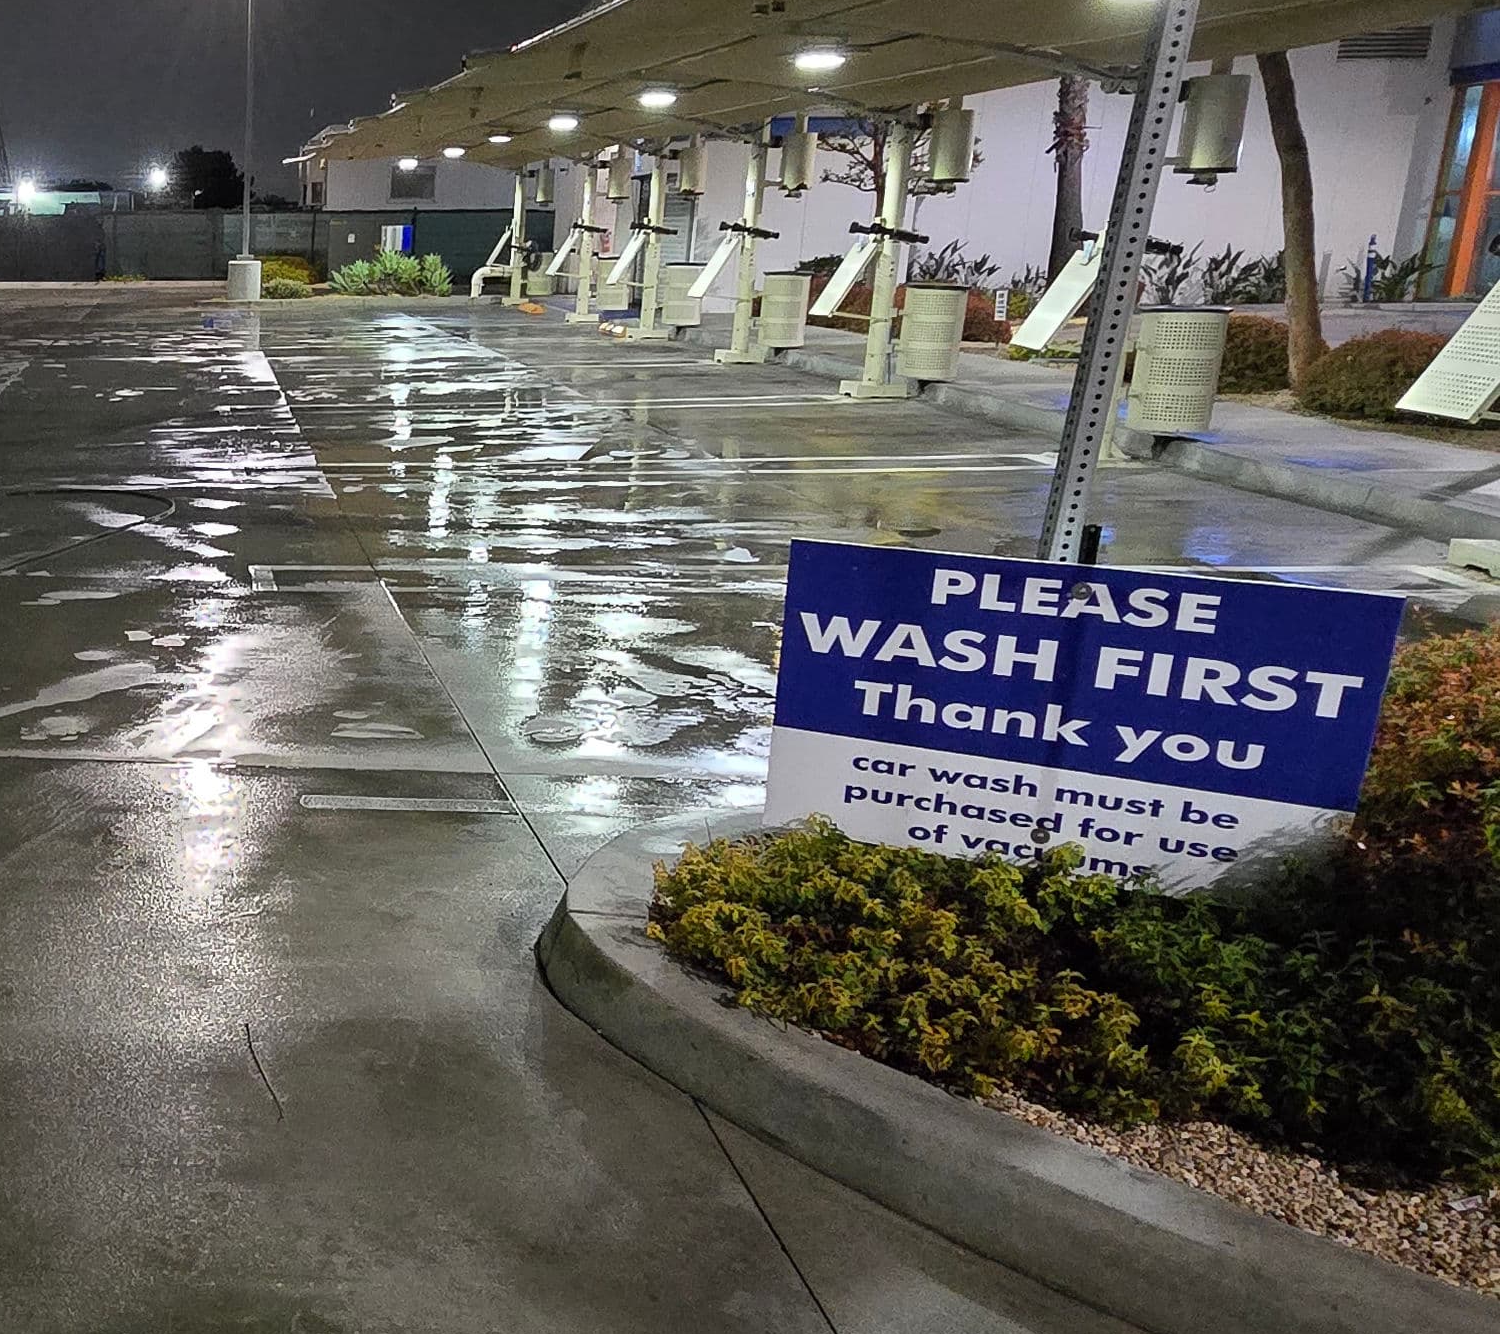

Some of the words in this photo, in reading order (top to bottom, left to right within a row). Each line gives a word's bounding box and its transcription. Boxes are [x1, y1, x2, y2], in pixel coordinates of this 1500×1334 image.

[931, 568, 1221, 634] PLEASE
[800, 611, 1059, 682] WASH
[1094, 646, 1364, 718] FIRST
[854, 679, 1092, 747] Thank
[1114, 725, 1265, 770] you
[844, 785, 1063, 833] purchased
[1078, 817, 1144, 846] for
[1159, 837, 1239, 862] use
[852, 757, 916, 777] car
[928, 767, 1038, 798] wash
[1055, 788, 1164, 818] must
[1180, 801, 1239, 830] be
[908, 825, 948, 844] of
